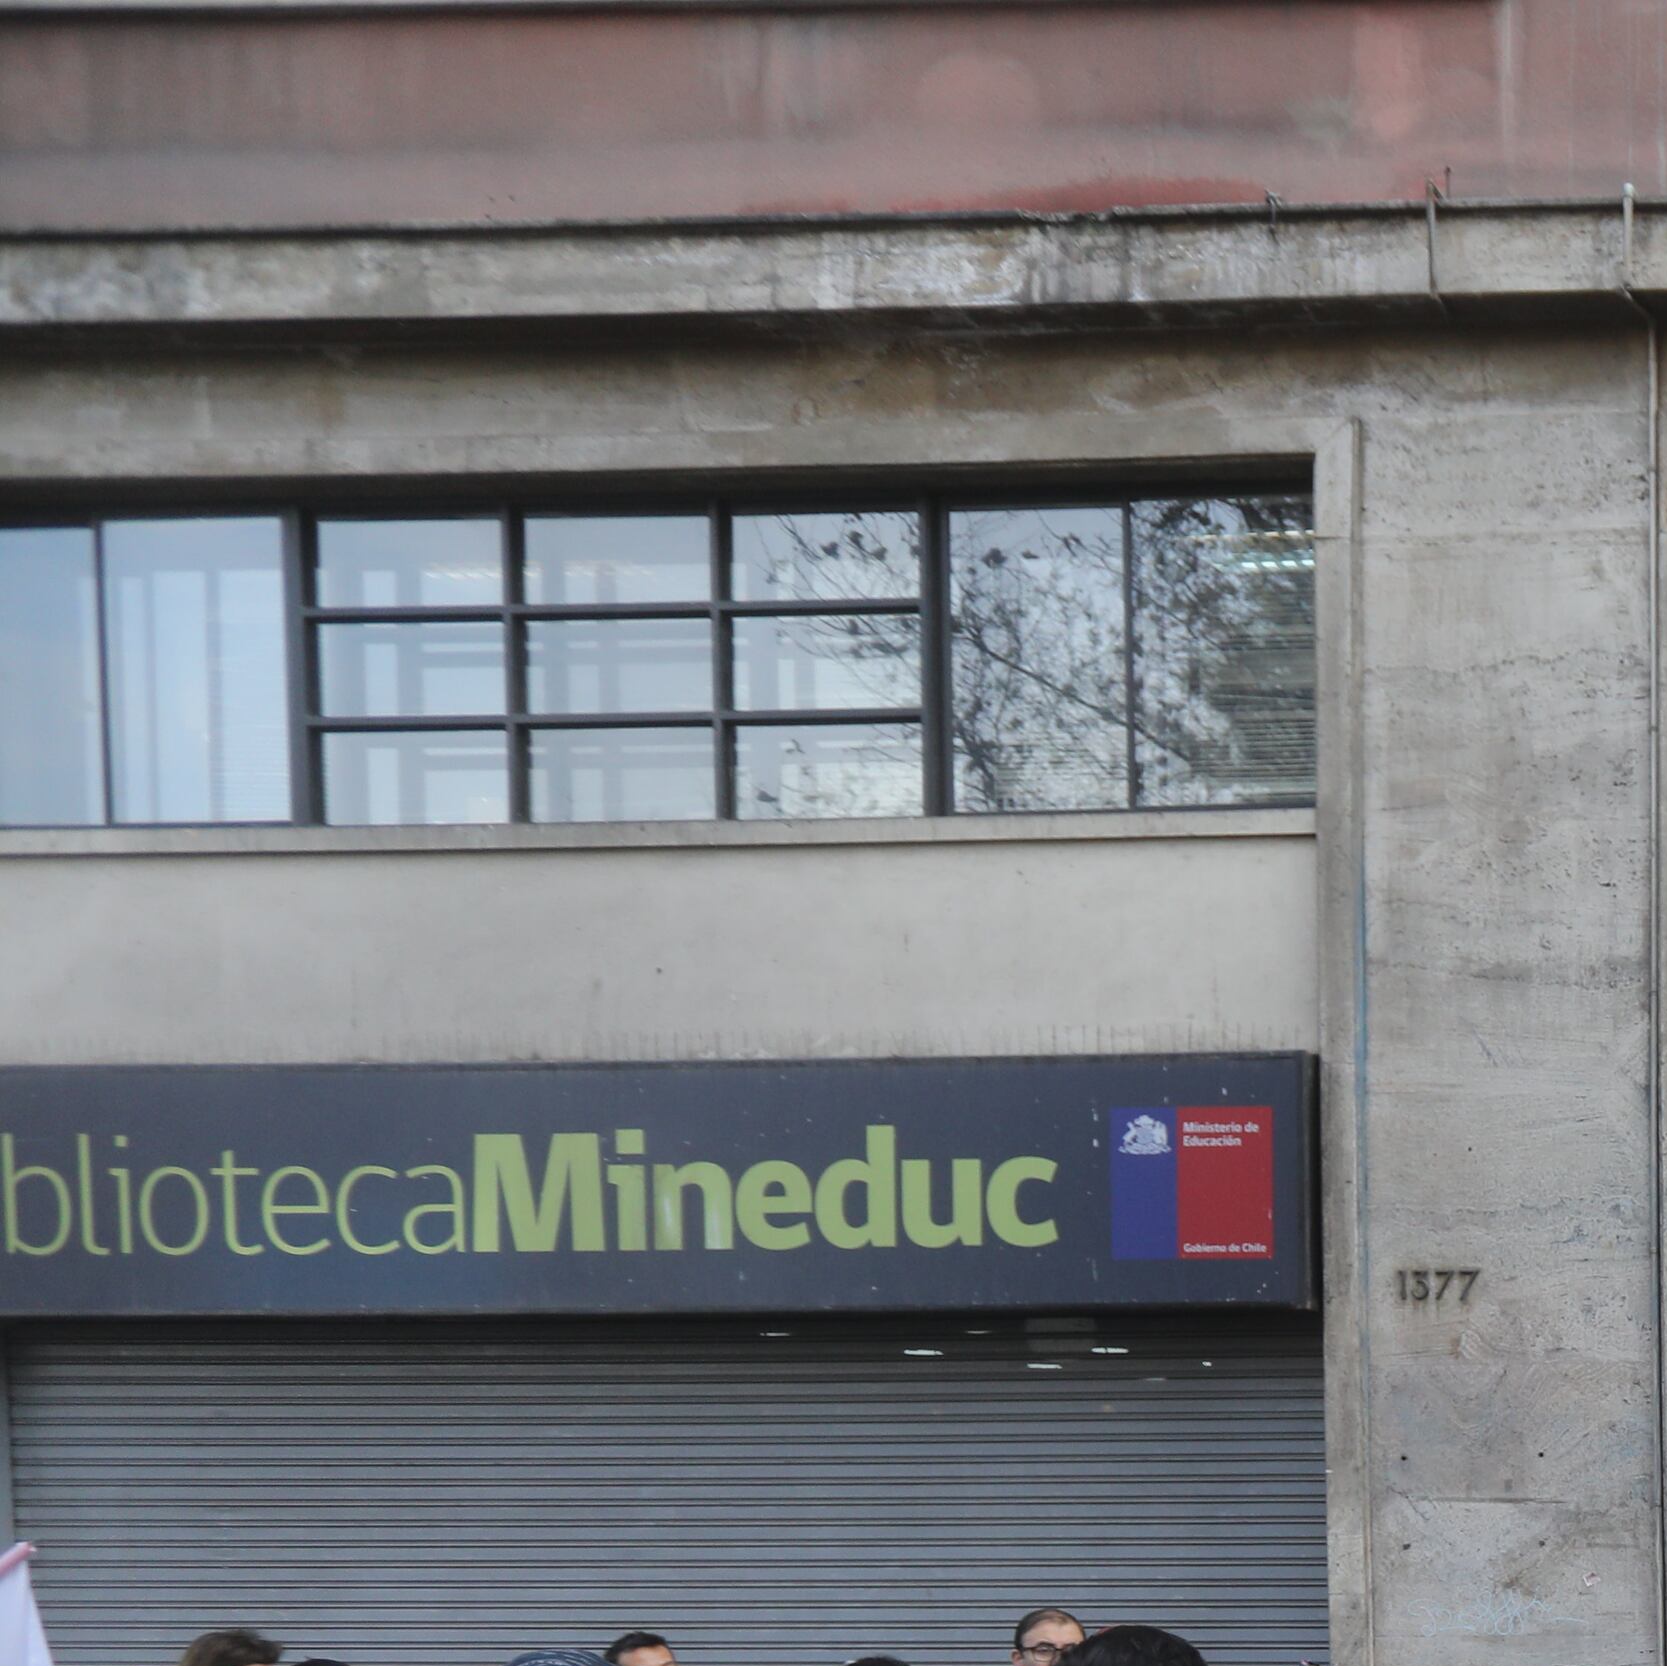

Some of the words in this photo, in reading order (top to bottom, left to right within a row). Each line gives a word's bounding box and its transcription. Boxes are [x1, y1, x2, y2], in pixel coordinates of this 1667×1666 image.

[1183, 1122, 1242, 1133] Ministerio
[1244, 1122, 1260, 1133] de
[1183, 1135, 1242, 1146] Educación
[1183, 1243, 1226, 1252] Gobierno
[1228, 1243, 1240, 1252] de
[1242, 1243, 1267, 1252] Chile
[1397, 1270, 1480, 1303] 1377
